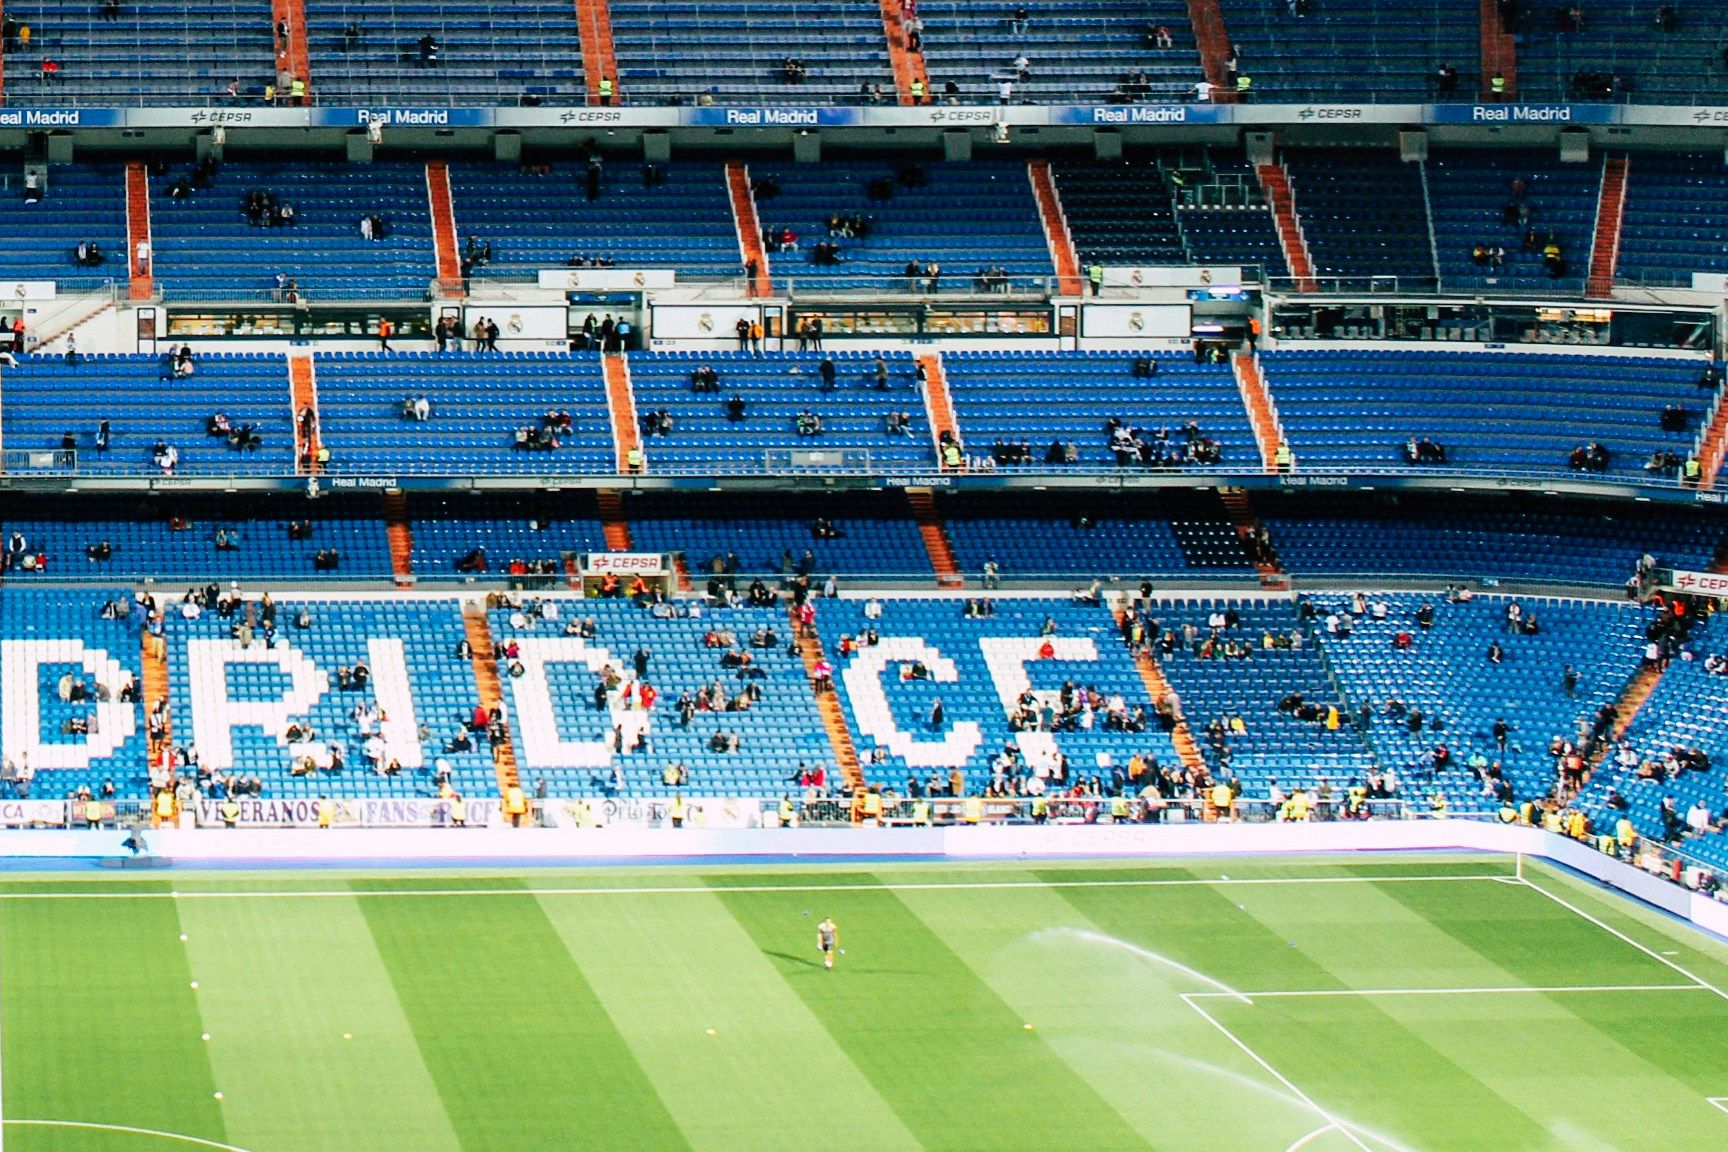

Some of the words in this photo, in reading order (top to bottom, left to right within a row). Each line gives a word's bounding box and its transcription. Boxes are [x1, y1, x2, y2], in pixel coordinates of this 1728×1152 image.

[26, 112, 79, 125] Madrid
[209, 112, 252, 122] CEPSA
[395, 110, 448, 124] Madrid
[578, 112, 621, 122] CEPSA
[727, 110, 761, 124] Real
[765, 110, 817, 124] Madrid
[948, 111, 991, 121] CEPSA
[1094, 108, 1128, 122] Real
[1132, 108, 1185, 122] Madrid
[1317, 109, 1362, 119] CEPSA
[1473, 107, 1509, 121] Real
[1513, 107, 1570, 121] Madrid
[612, 557, 658, 568] CEPSA
[842, 636, 1098, 768] CF
[200, 801, 320, 822] VEERANOS
[366, 801, 419, 823] FANS
